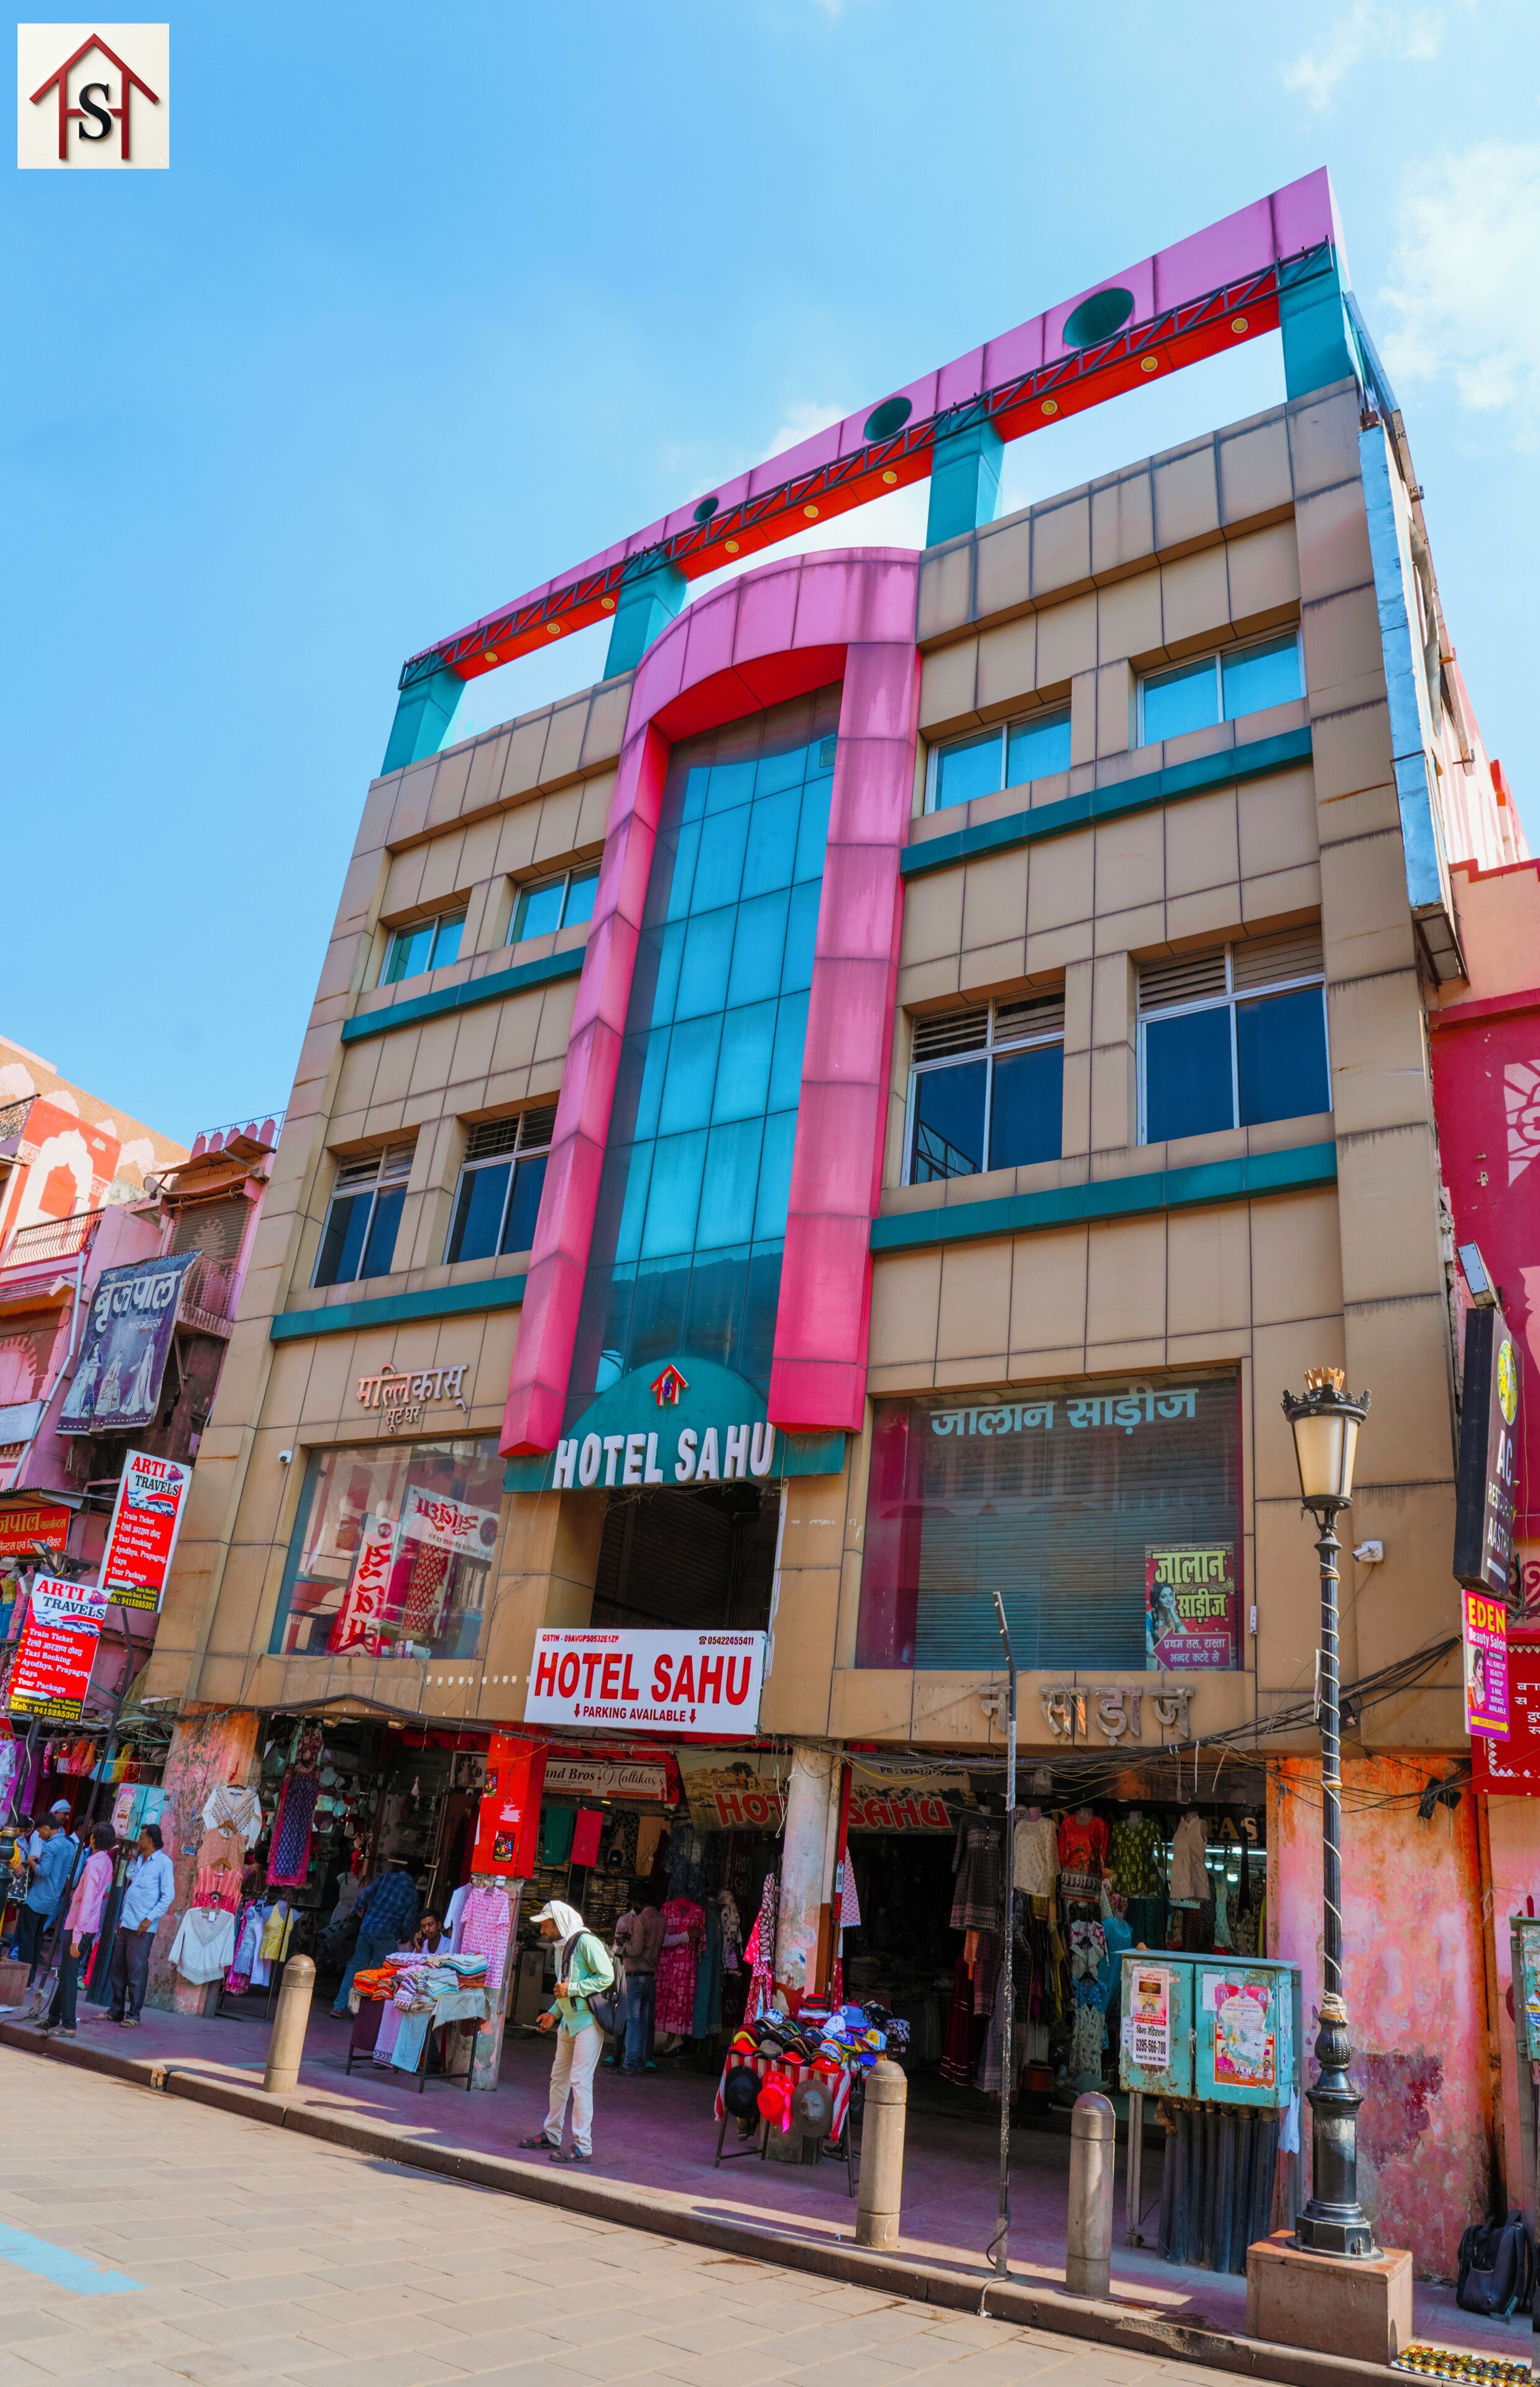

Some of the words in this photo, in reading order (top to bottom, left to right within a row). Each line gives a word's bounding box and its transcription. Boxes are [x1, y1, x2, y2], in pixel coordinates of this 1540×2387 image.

[94, 1270, 181, 1333] बृजपाल
[929, 1401, 1055, 1436] जालान
[1066, 1380, 1199, 1435] साड़ीज
[385, 1407, 404, 1434] सूट
[405, 1405, 421, 1423] घर
[552, 1432, 663, 1489] HOTEL
[674, 1422, 776, 1483] SAHU
[1496, 1429, 1513, 1487] AC
[131, 1456, 167, 1479] ARTI
[135, 1474, 179, 1497] TRAVELS
[123, 1511, 137, 1521] Train
[139, 1514, 155, 1525] Ticket
[121, 1522, 132, 1533] रेलवे
[132, 1525, 150, 1537] आरक्षण
[119, 1534, 130, 1543] Taxi
[131, 1537, 153, 1550] Booking
[113, 1556, 127, 1566] Gaya
[116, 1545, 139, 1557] Ayodhya,
[140, 1550, 167, 1565] Prayagraj,
[111, 1566, 124, 1576] Tour
[125, 1570, 147, 1582] Package
[1152, 1550, 1227, 1584] जालान
[36, 1579, 86, 1602] ARTI
[43, 1596, 106, 1619] TRAVELS
[109, 1596, 121, 1604] ob.:
[121, 1597, 155, 1611] 9415285301
[1176, 1587, 1227, 1624] साड़ीज
[1468, 1596, 1506, 1637] EDEN
[29, 1628, 49, 1639] Train
[51, 1632, 74, 1644] Ticket
[542, 1634, 560, 1642] GSTIN
[564, 1635, 620, 1644] 09AVGPS0532E1ZP
[707, 1636, 754, 1646] 05422455411
[1163, 1639, 1183, 1649] प्रथम
[1186, 1639, 1201, 1650] तल,
[1203, 1638, 1226, 1649] रास्ता
[1468, 1627, 1490, 1649] Beauty
[1490, 1634, 1506, 1652] Salon
[26, 1637, 42, 1648] रेलवे
[42, 1641, 67, 1653] आरक्षण
[24, 1648, 40, 1658] Taxi
[42, 1652, 72, 1665] Booking
[1170, 1653, 1190, 1663] अन्दर
[1192, 1650, 1209, 1663] कटरे
[1211, 1650, 1221, 1663] से
[19, 1667, 38, 1678] Gaya
[21, 1658, 54, 1672] Ayodhya,
[1490, 1668, 1503, 1678] BEAUTY
[1493, 1661, 1501, 1669] KIND
[17, 1677, 34, 1686] Tour
[36, 1681, 66, 1694] Package
[534, 1651, 639, 1701] HOTEL
[651, 1653, 752, 1706] SAHU
[1490, 1678, 1504, 1687] MAKEUP
[1495, 1688, 1503, 1696] NAIL
[62, 1704, 81, 1713] Varanasi
[65, 1699, 81, 1707] Market,
[1490, 1696, 1505, 1705] SERVICE
[10, 1701, 32, 1712] Mob.:
[34, 1706, 79, 1720] 9415285301
[583, 1706, 627, 1720] PARKING
[630, 1708, 687, 1722] AVAILABLE
[1488, 1704, 1506, 1715] AVAILABLE
[1478, 1718, 1488, 1727] SAHU
[568, 1768, 595, 1781] Bros
[1137, 2024, 1147, 2035] बिना
[1136, 2038, 1166, 2056] 6395-566-700
